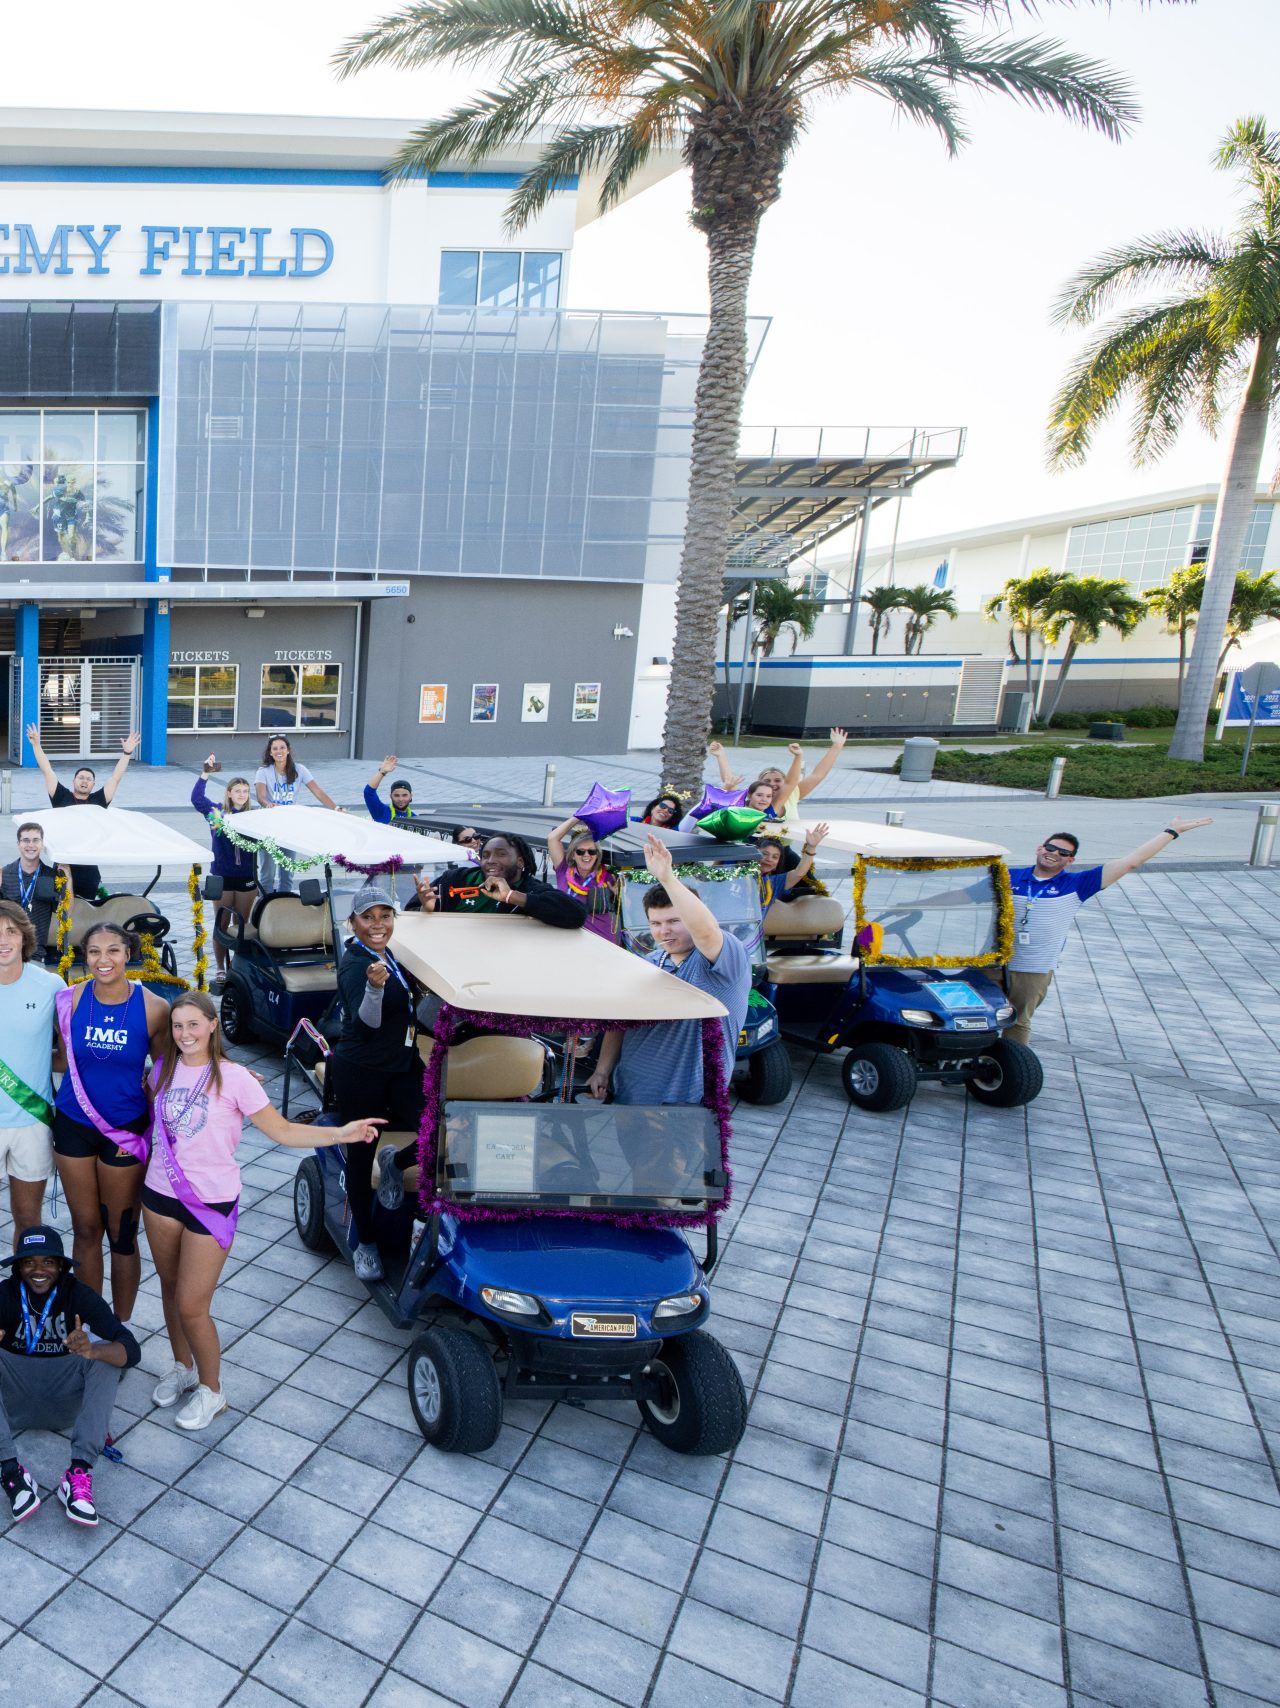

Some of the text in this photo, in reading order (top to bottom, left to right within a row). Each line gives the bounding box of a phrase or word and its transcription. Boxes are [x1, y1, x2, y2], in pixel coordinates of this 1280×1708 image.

[139, 225, 335, 278] FIELD
[384, 585, 408, 594] 5650
[171, 650, 230, 662] TICKETS
[274, 649, 333, 661] TICKETS
[273, 782, 295, 792] IMG
[84, 1026, 128, 1045] IMG
[86, 1042, 124, 1051] ACADEMY
[591, 1323, 635, 1333] AMERICAN PRIDE
